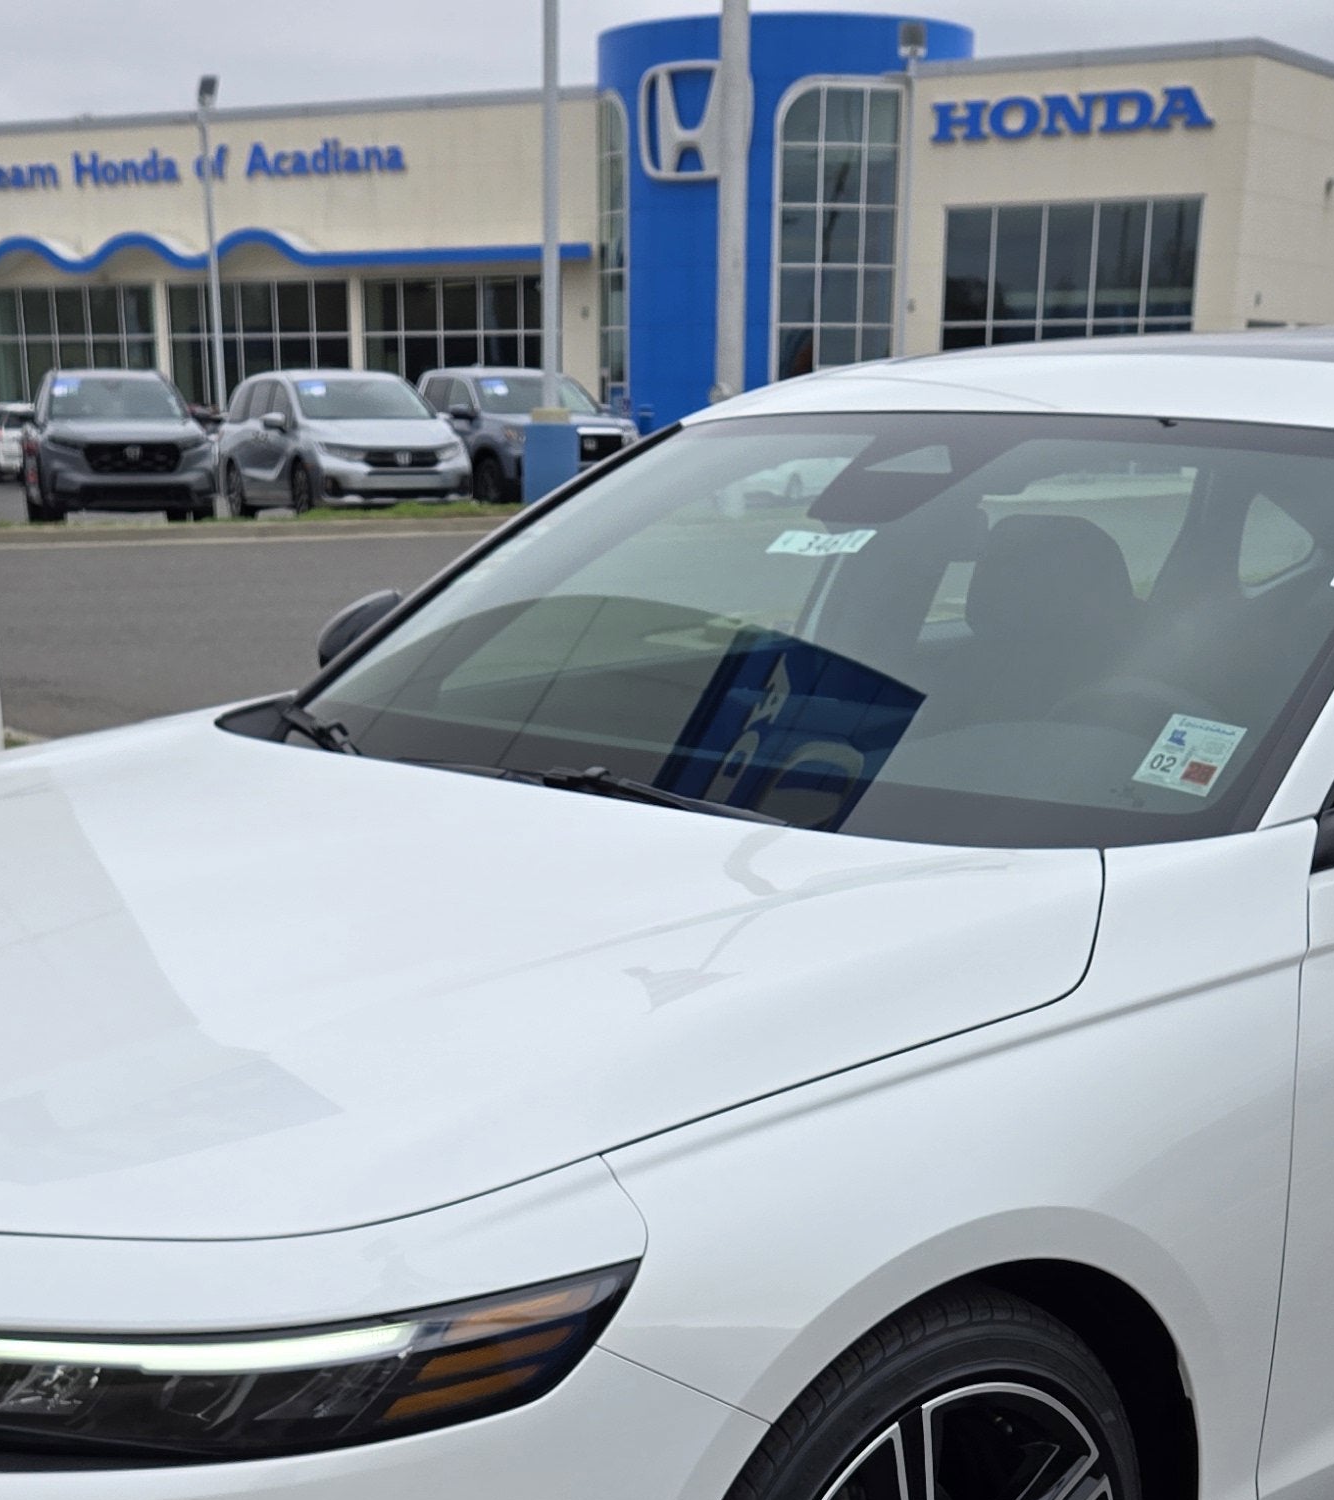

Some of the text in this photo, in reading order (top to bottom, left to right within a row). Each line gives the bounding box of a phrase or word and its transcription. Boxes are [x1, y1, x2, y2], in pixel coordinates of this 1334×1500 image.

[930, 86, 1215, 144] HONDA
[72, 147, 181, 187] Honda
[194, 143, 229, 181] of
[246, 137, 406, 180] Acadiana
[1149, 752, 1178, 774] 02
